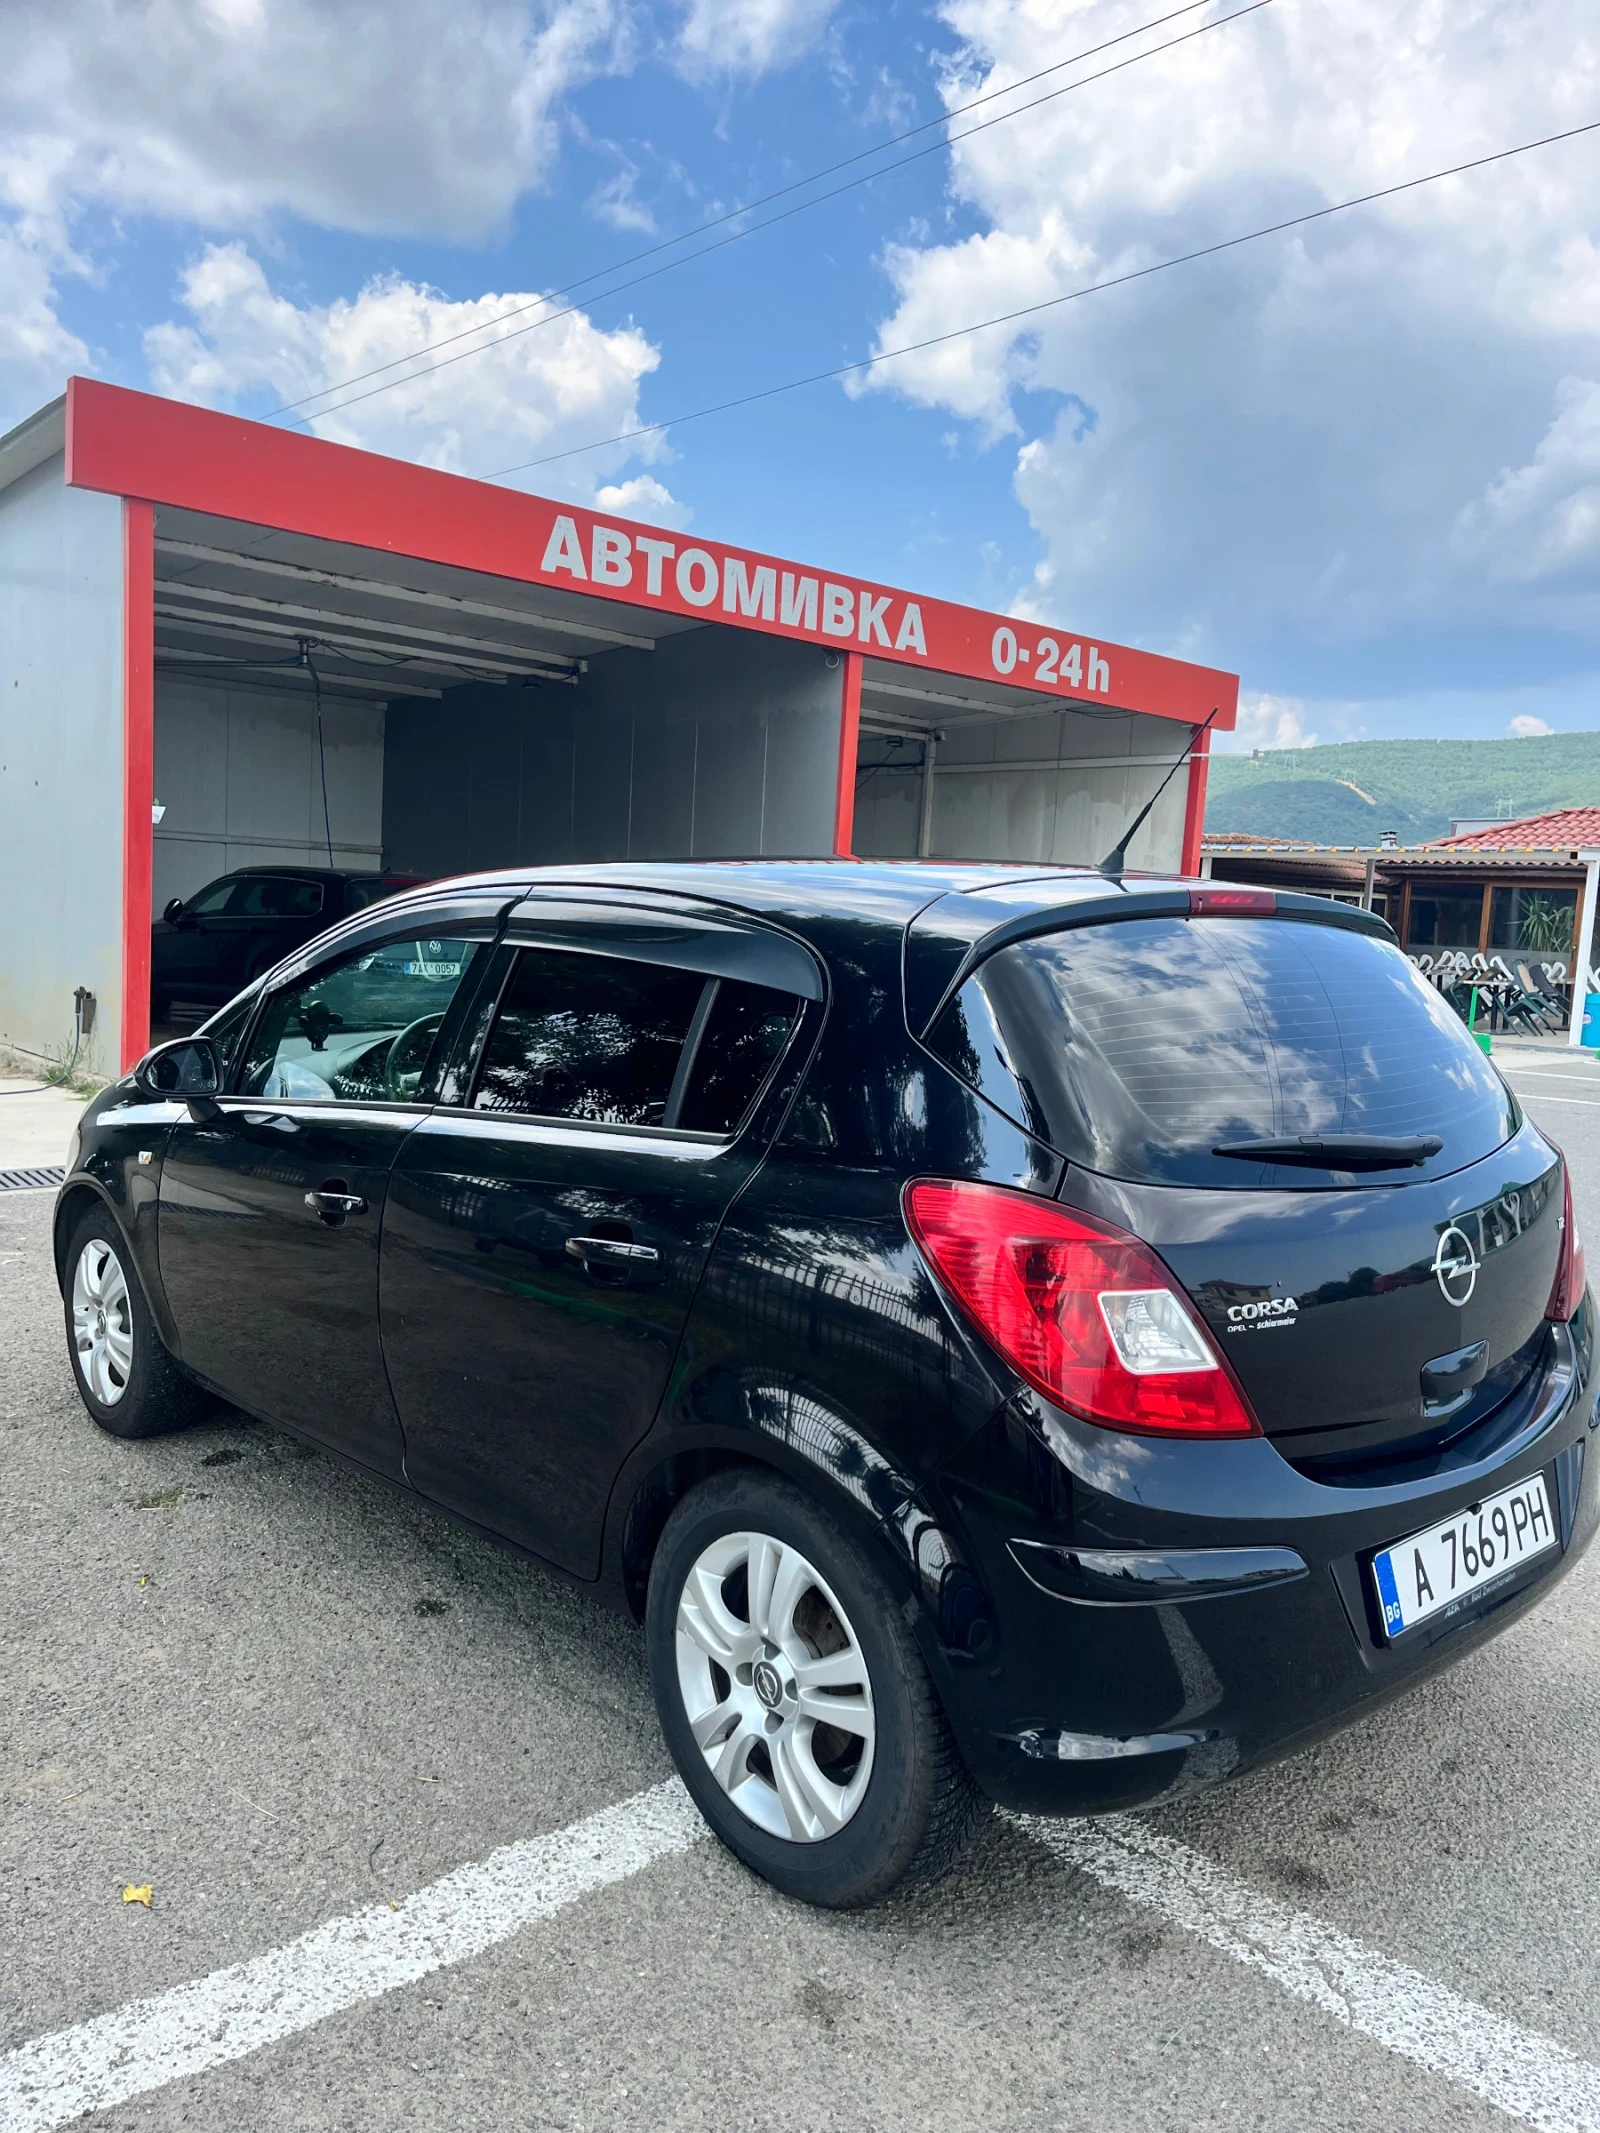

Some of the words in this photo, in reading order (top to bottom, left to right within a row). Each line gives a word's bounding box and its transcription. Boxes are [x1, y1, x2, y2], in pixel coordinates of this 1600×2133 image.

[540, 514, 928, 656] АВТОМИВКА
[435, 963, 456, 973] 0057
[1227, 1297, 1299, 1322] CORSA
[1413, 1548, 1435, 1608] A
[1385, 1603, 1401, 1623] BG
